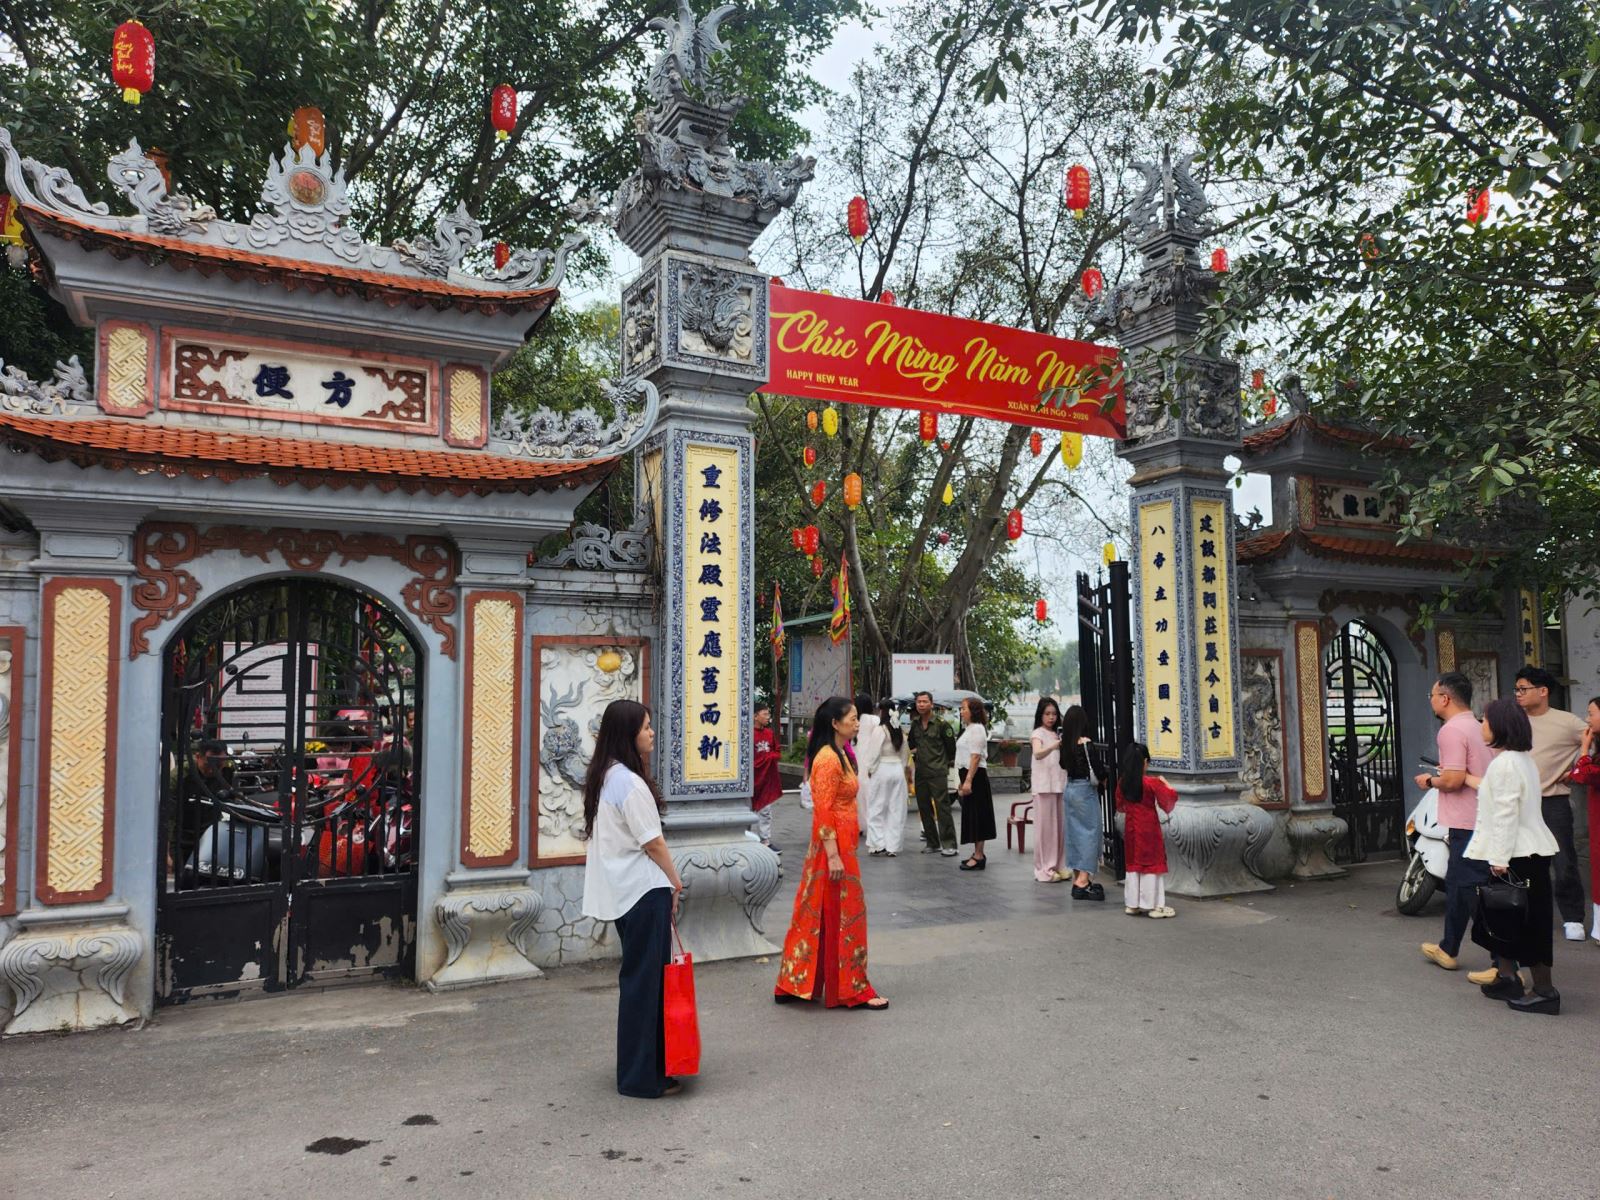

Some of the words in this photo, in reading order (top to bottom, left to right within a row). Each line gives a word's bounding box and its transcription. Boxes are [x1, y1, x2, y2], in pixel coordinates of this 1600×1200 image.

[770, 310, 859, 359] Chúc
[864, 320, 960, 392] Mừng
[964, 337, 1032, 385] Năm
[786, 369, 813, 382] HAPPY
[816, 373, 835, 385] NEW
[839, 376, 859, 388] YEAR
[1007, 401, 1029, 412] XUÂN
